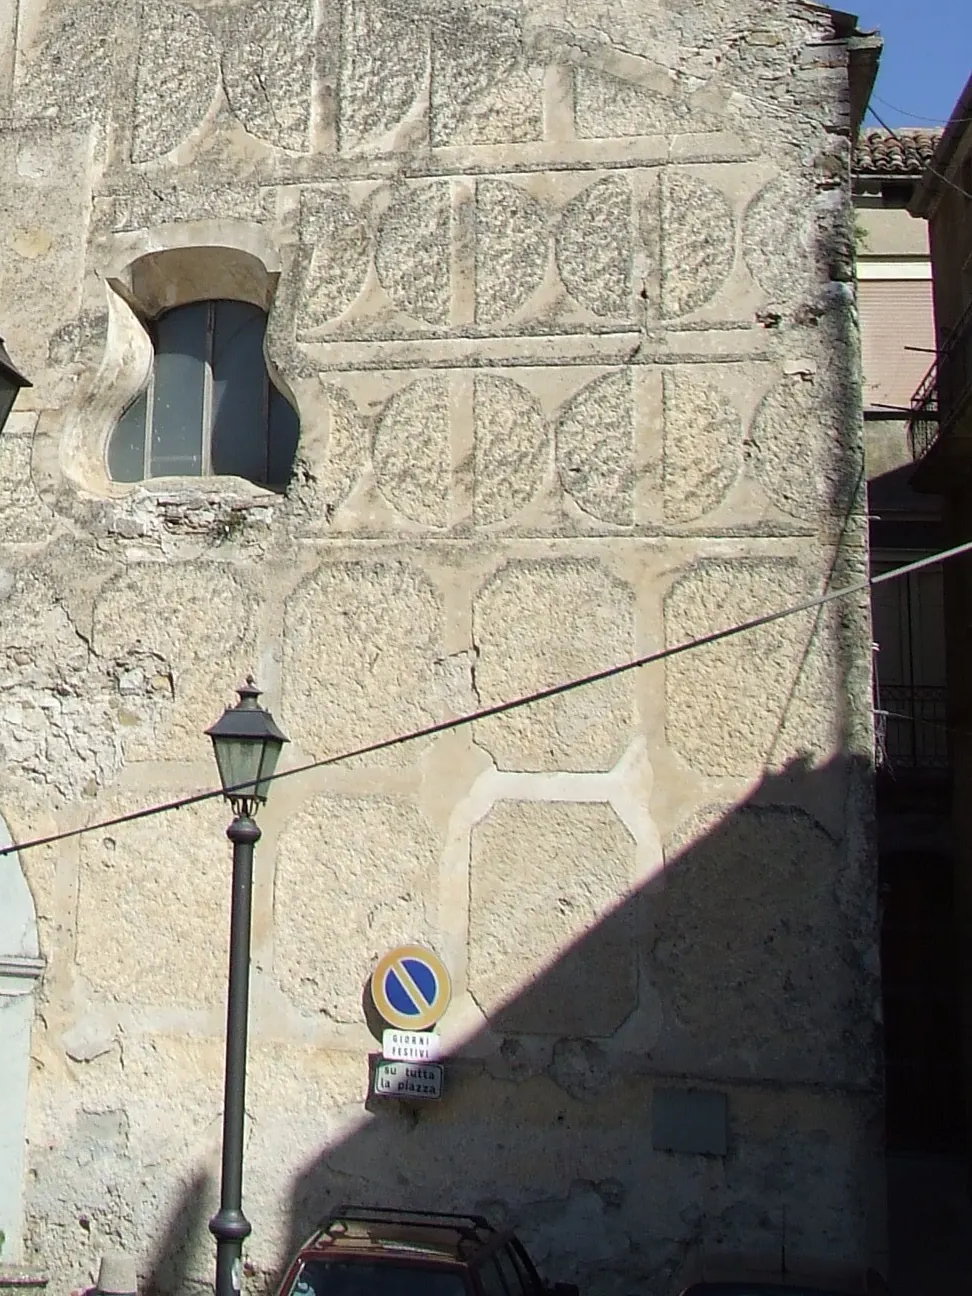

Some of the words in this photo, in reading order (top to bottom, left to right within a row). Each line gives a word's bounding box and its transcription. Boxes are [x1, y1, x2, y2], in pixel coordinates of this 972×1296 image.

[392, 1035, 429, 1045] GIORNI
[392, 1047, 428, 1058] FESTIVI
[384, 1067, 396, 1075] su
[405, 1068, 435, 1079] tutta
[381, 1078, 390, 1088] la
[398, 1080, 436, 1094] piazza
